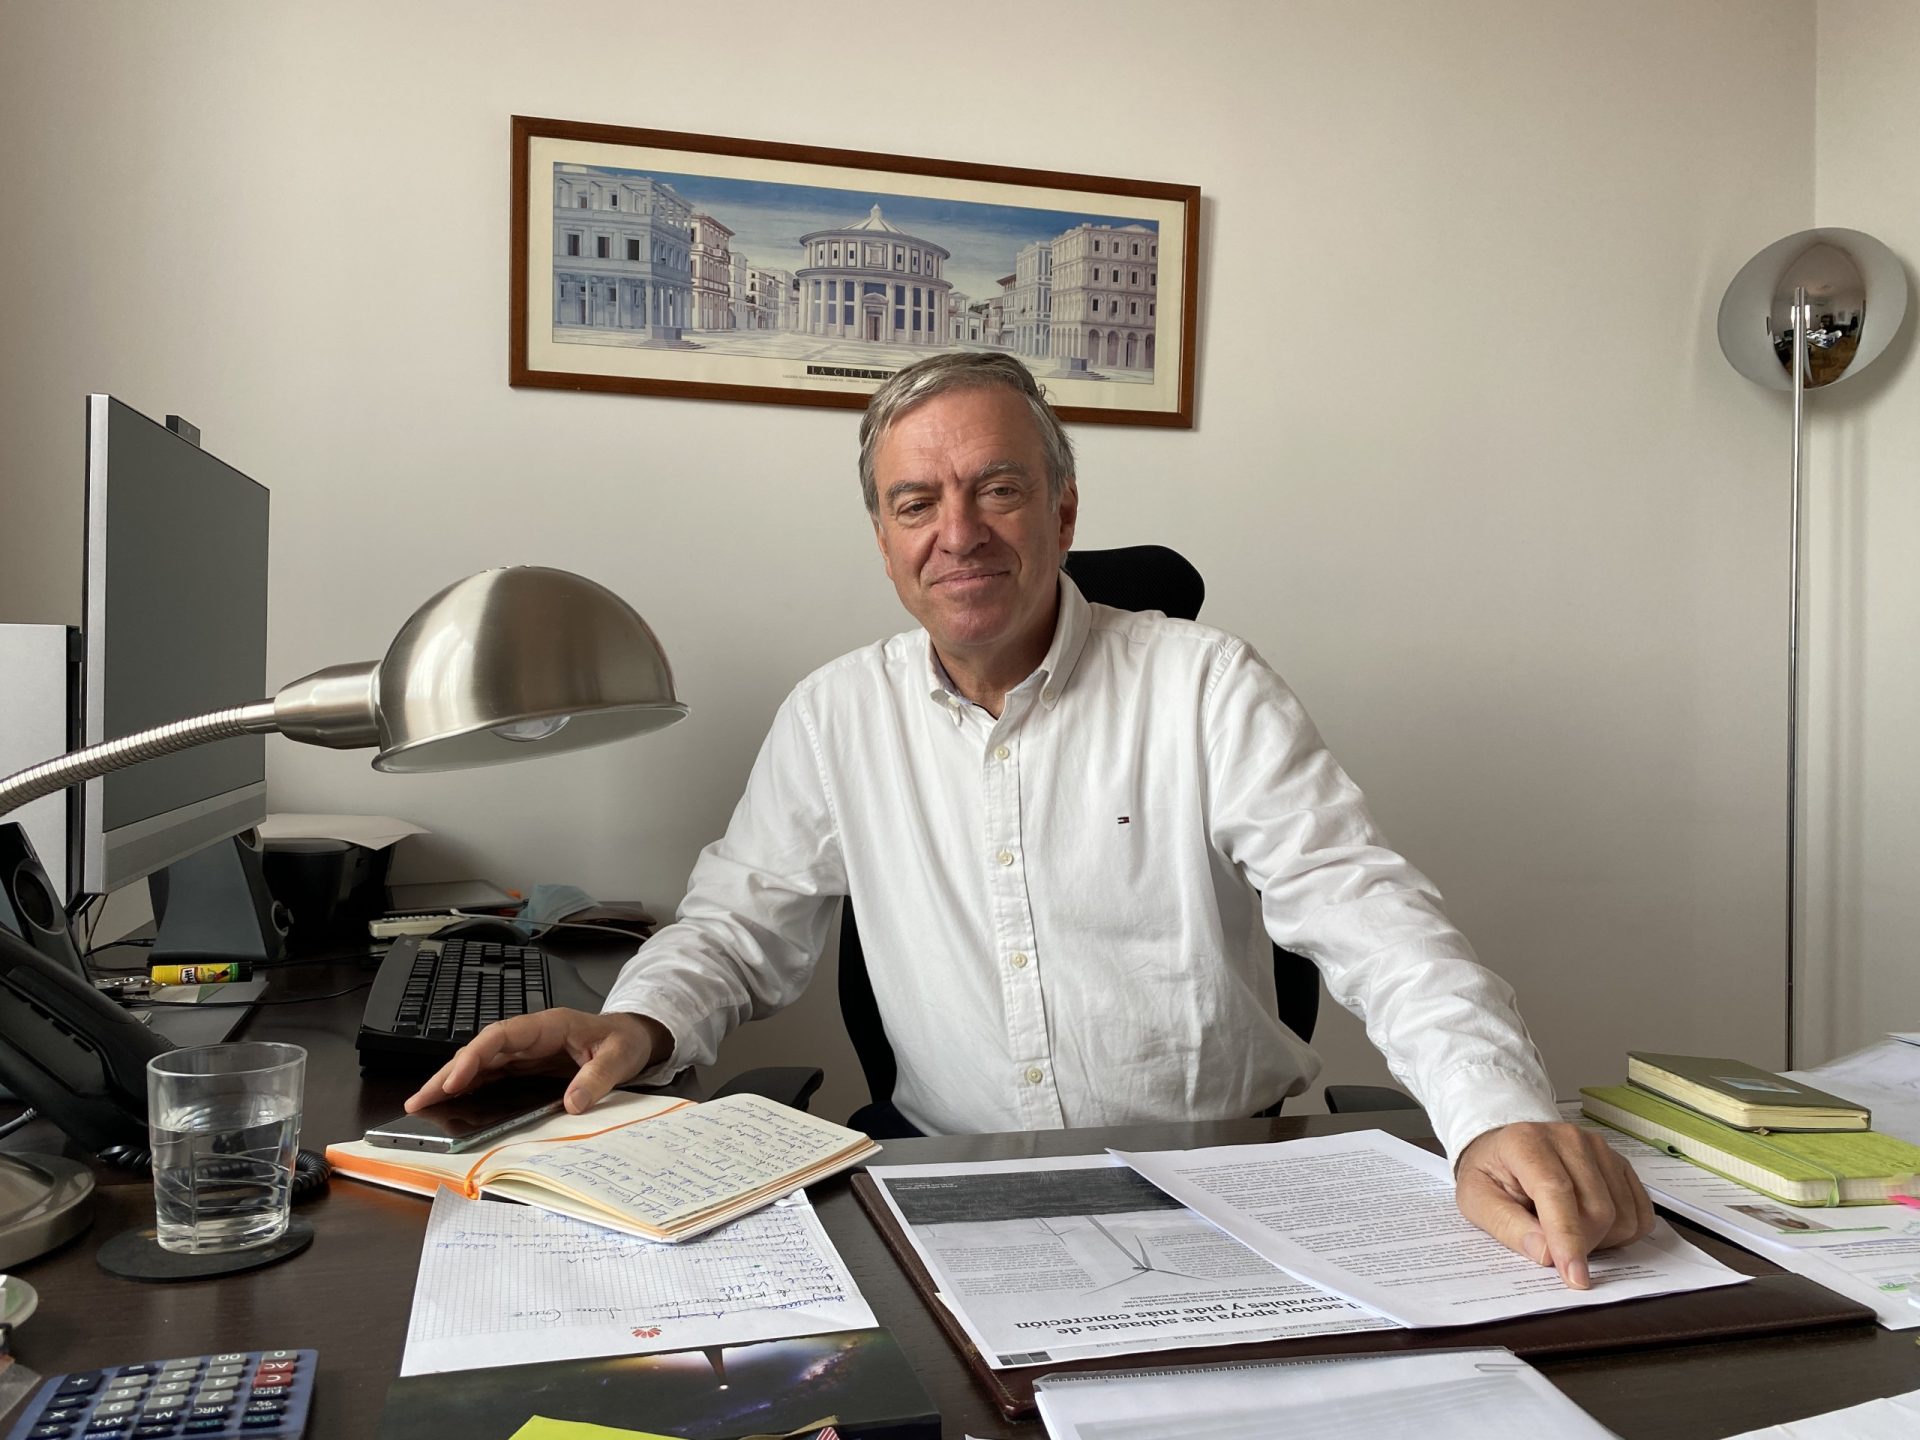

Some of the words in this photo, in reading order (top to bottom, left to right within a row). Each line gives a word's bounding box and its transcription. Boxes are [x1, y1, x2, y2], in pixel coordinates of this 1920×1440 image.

[810, 366, 826, 375] LA
[1182, 1304, 1228, 1315] pide
[1232, 1302, 1246, 1310] y
[1283, 1304, 1343, 1314] sector
[1135, 1309, 1180, 1319] más
[1216, 1309, 1280, 1320] apoya
[1013, 1314, 1131, 1330] concreción
[1182, 1315, 1216, 1323] las
[1086, 1318, 1179, 1332] subastas
[1056, 1326, 1082, 1335] de
[274, 1350, 286, 1358] 0
[222, 1366, 228, 1374] 1
[264, 1361, 289, 1370] AC
[172, 1370, 184, 1379] 2
[266, 1374, 282, 1382] C
[215, 1378, 227, 1386] 4
[166, 1382, 177, 1392] 5
[160, 1396, 172, 1405] 8
[208, 1392, 220, 1400] 7
[108, 1402, 122, 1411] 9
[193, 1405, 224, 1414] MRC
[92, 1416, 122, 1426] M+
